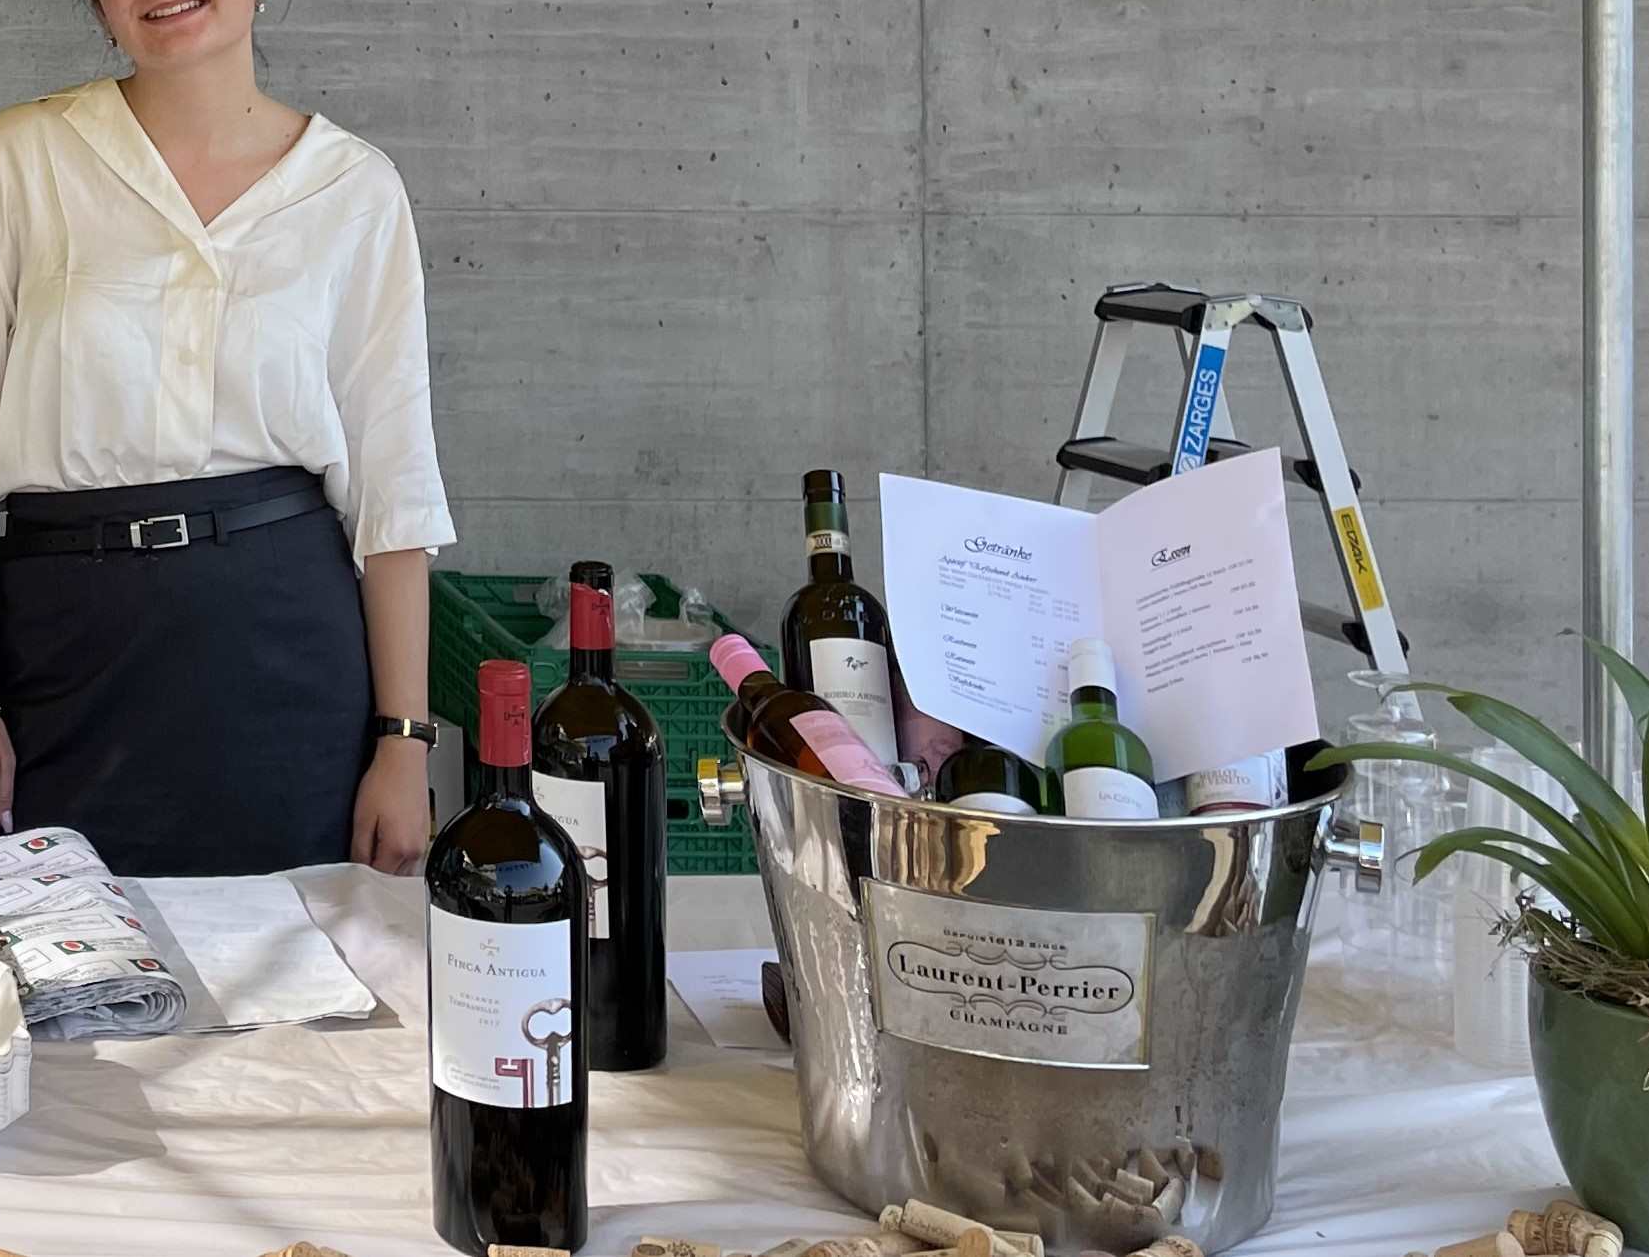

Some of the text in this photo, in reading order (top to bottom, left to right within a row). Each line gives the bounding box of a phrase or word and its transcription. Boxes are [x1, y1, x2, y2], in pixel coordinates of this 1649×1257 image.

[1182, 368, 1218, 452] ZARGES
[963, 536, 1033, 561] Getränke
[447, 953, 548, 979] FINCA ANTIGUA
[898, 953, 1121, 1001] Laurent-Perrier
[949, 1010, 1070, 1036] CHAMPAGNE
